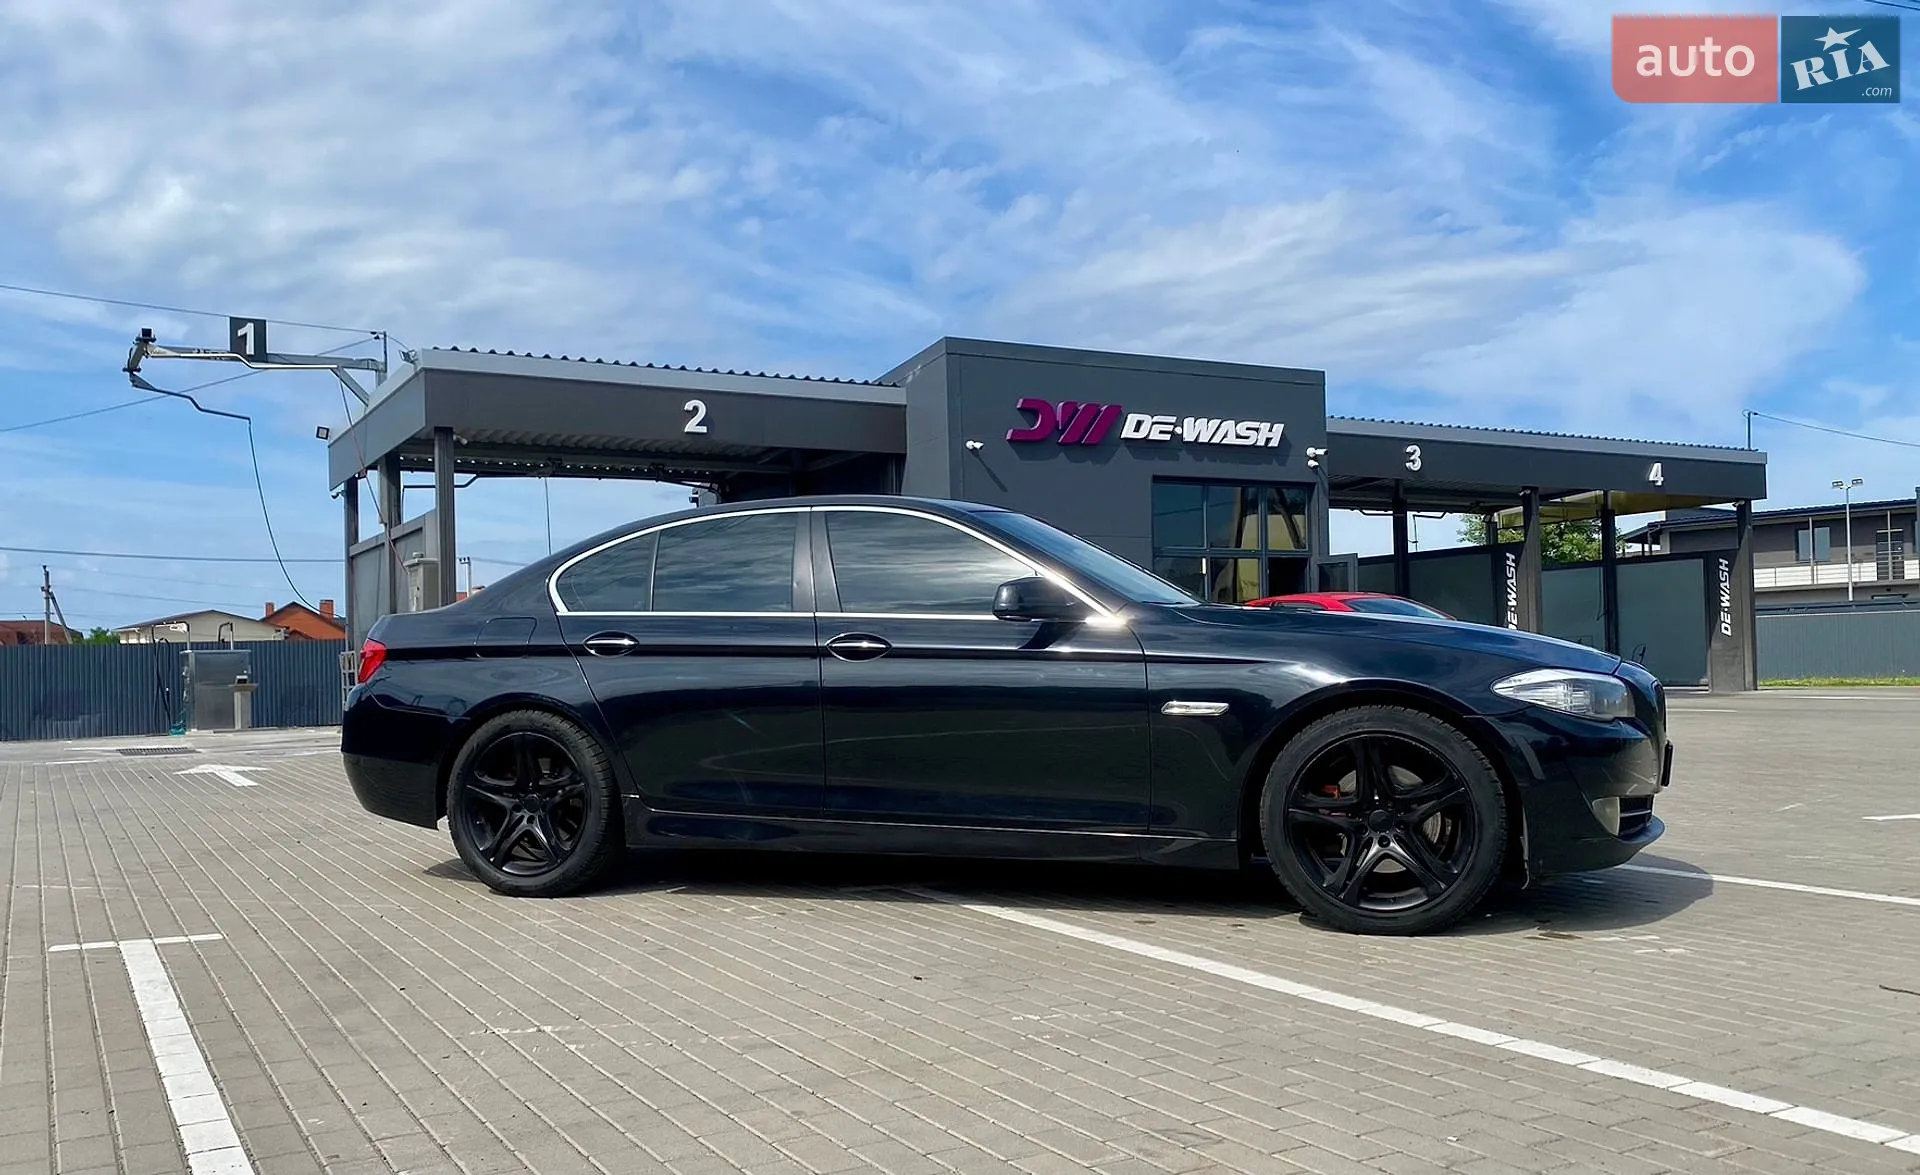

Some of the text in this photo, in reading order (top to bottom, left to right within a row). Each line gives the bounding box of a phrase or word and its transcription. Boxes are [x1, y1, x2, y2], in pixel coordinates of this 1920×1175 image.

[238, 322, 255, 355] 1
[683, 399, 708, 433] 2
[1405, 445, 1422, 471] 3
[1649, 462, 1664, 486] 4
